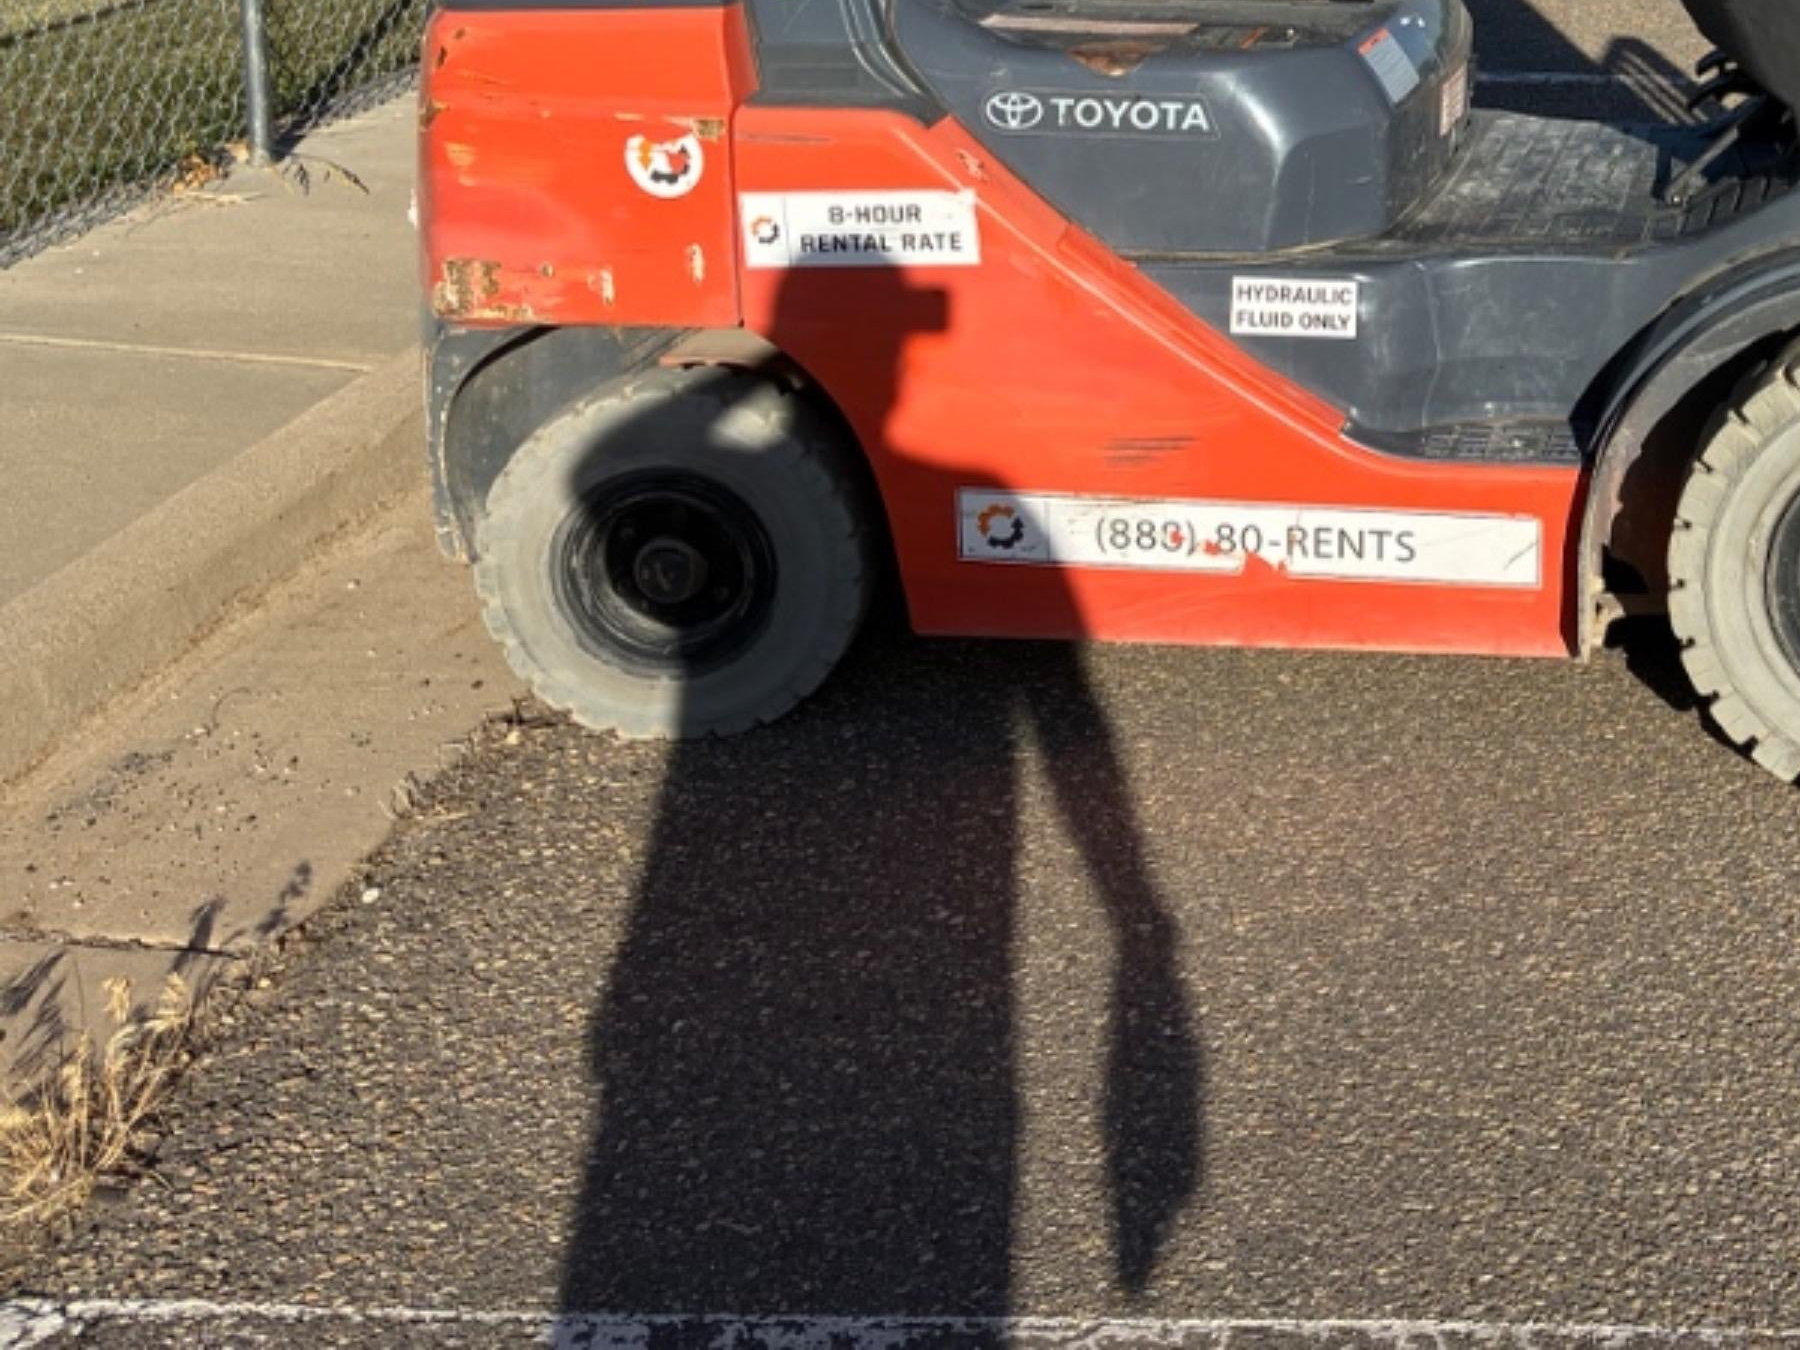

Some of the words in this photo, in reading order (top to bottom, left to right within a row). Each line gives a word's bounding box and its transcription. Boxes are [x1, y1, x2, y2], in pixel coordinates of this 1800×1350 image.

[1050, 98, 1209, 131] TOYOTA
[828, 204, 922, 225] 8-HOUR
[800, 233, 893, 254] RENTAL
[902, 231, 963, 252] RATE
[1237, 283, 1353, 306] HYDRAULIC
[1236, 309, 1294, 329] FLUID
[1298, 311, 1351, 331] ONLY
[1215, 523, 1417, 563] 80-RENTS
